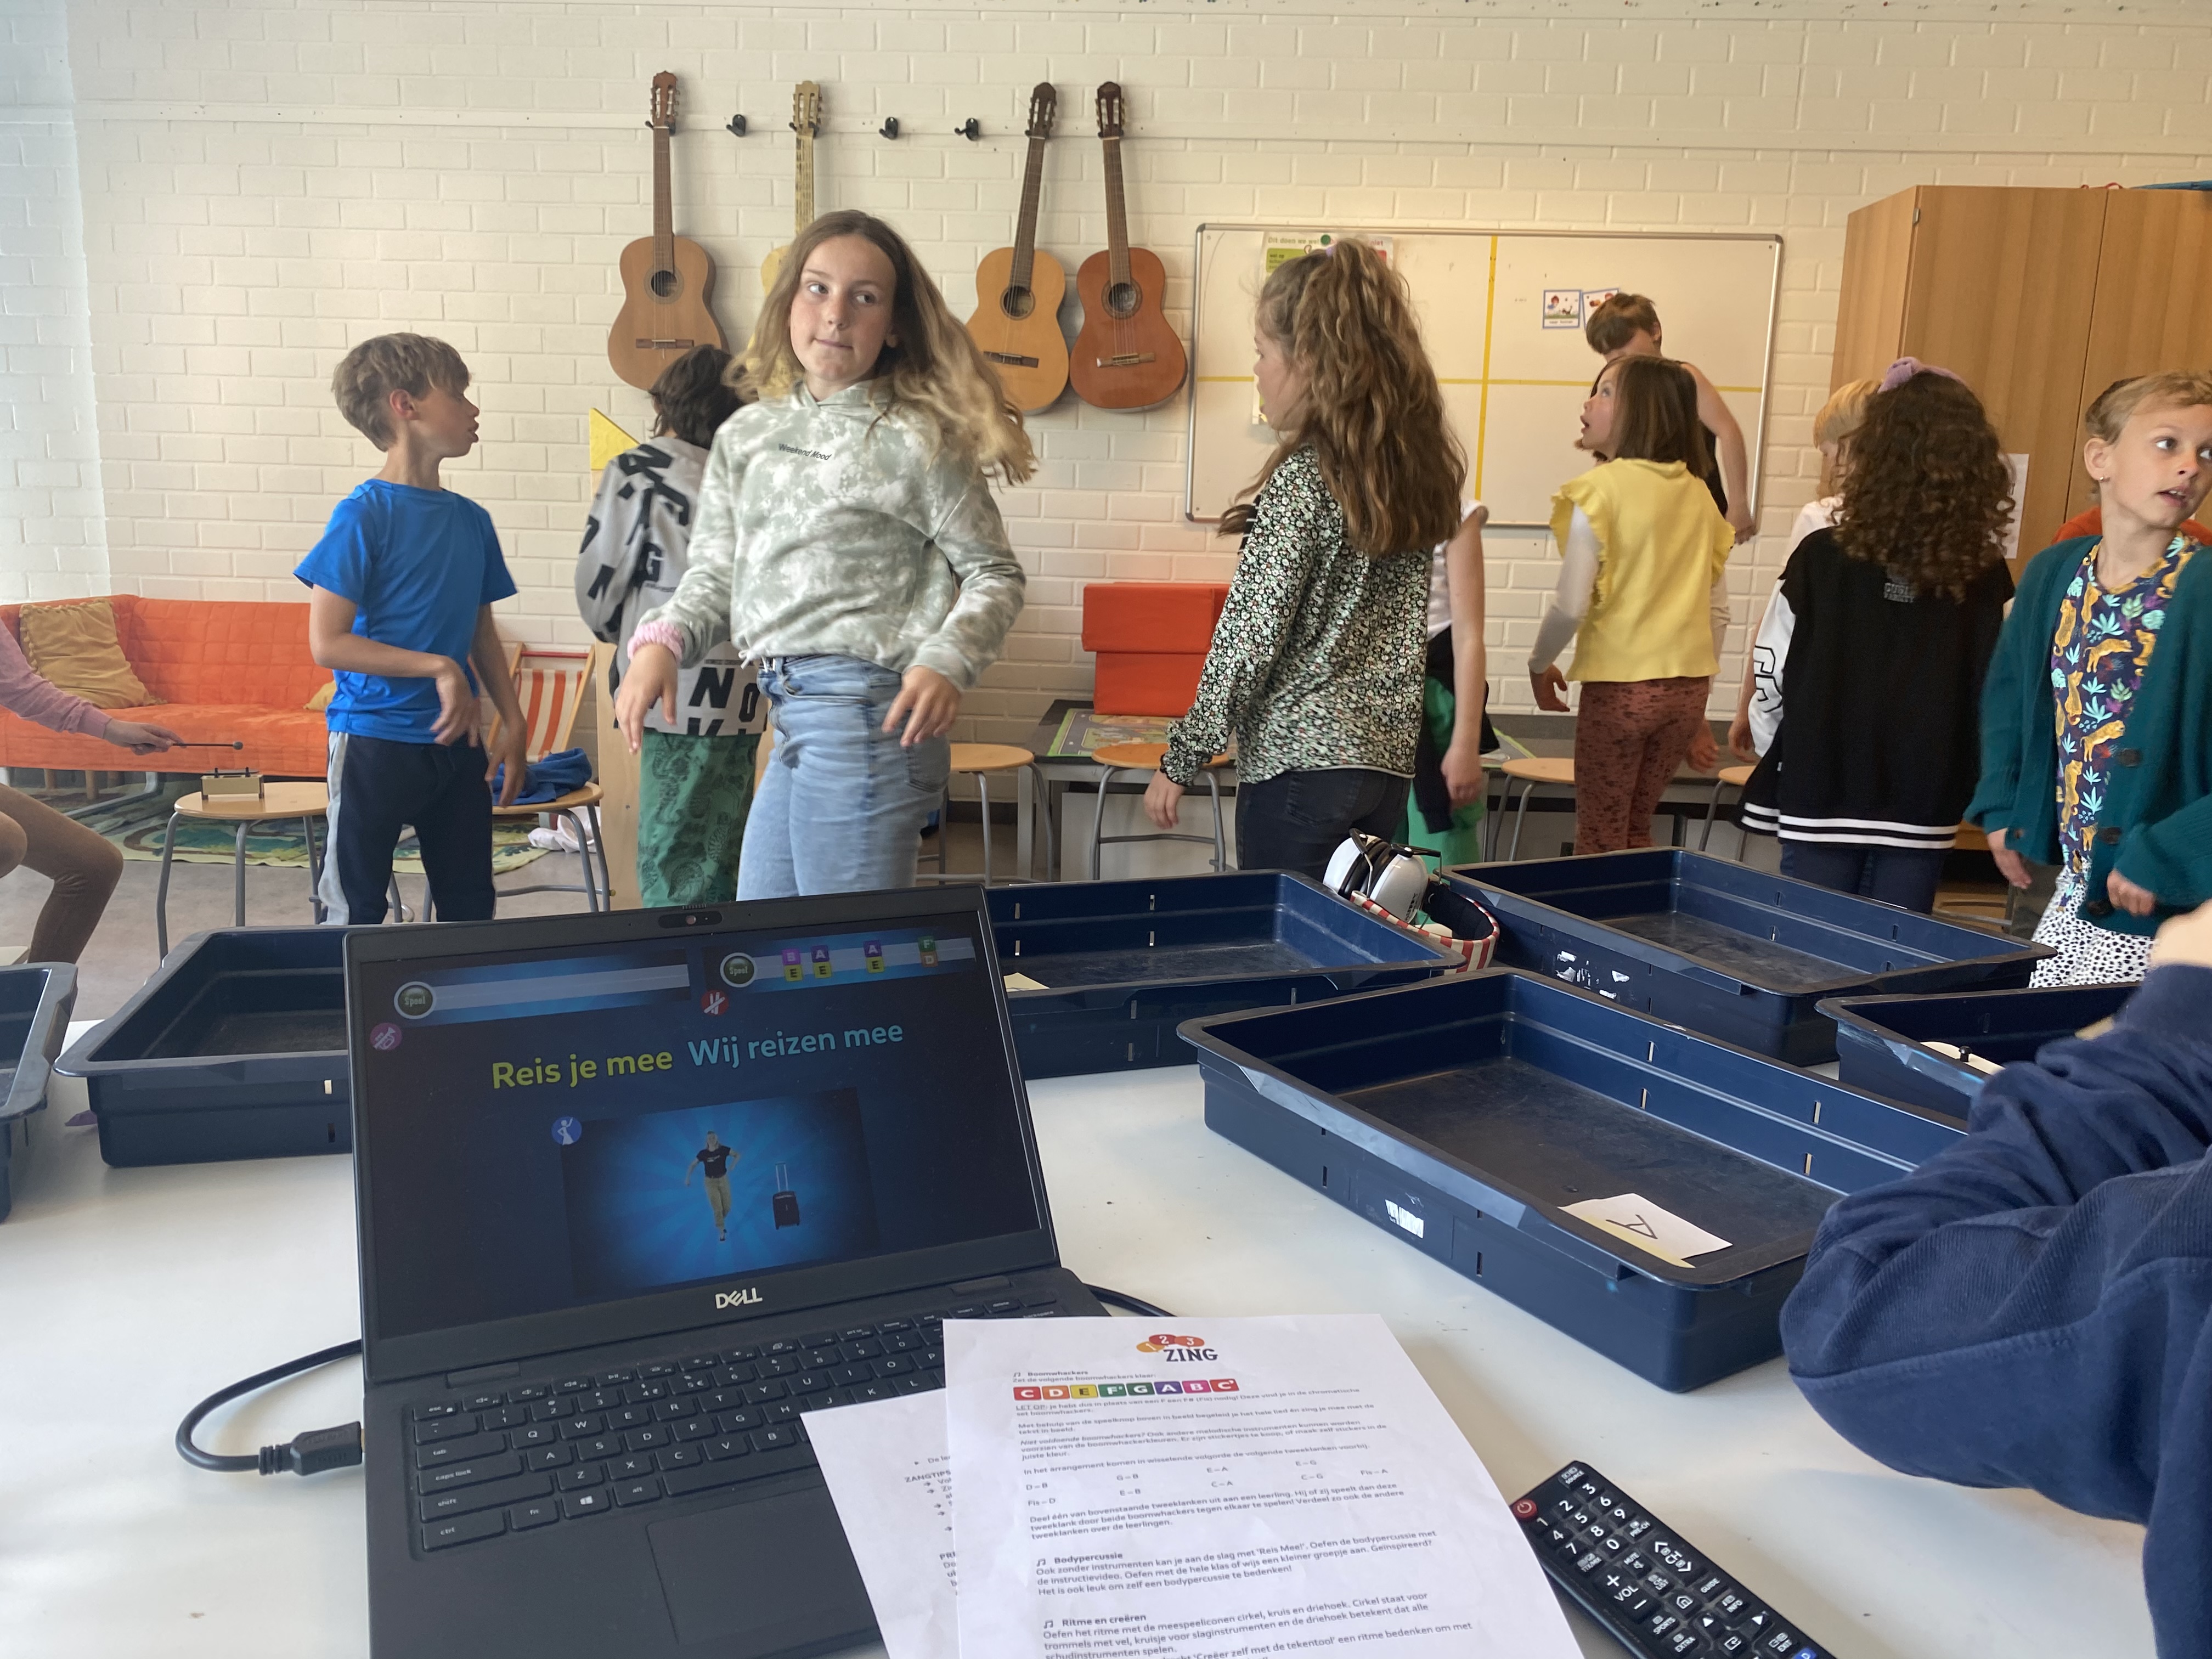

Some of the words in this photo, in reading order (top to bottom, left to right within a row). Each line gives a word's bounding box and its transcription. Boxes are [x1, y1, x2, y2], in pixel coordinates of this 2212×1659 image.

[778, 443, 812, 456] Weekend
[810, 451, 832, 461] Mood
[689, 667, 735, 708] N
[816, 950, 826, 960] A
[868, 945, 878, 954] A
[787, 952, 795, 962] B
[926, 955, 934, 964] D
[819, 966, 827, 975] E
[872, 961, 880, 969] E
[789, 968, 798, 978] E
[492, 1057, 561, 1090] Reis
[569, 1054, 597, 1088] je
[606, 1051, 673, 1076] mee
[687, 1036, 740, 1069] Wij
[747, 1030, 836, 1060] reizen
[844, 1025, 903, 1048] mee
[1605, 1214, 1658, 1239] A
[715, 1286, 763, 1310] DELL
[1159, 1335, 1169, 1345] 2
[1186, 1337, 1194, 1346] 3
[1163, 1348, 1218, 1362] ZING
[1020, 1389, 1034, 1398] C
[1049, 1389, 1064, 1398] D
[1079, 1387, 1089, 1396] E
[1133, 1385, 1148, 1394] G
[1161, 1383, 1176, 1392] A
[1189, 1383, 1204, 1391] B
[1582, 1483, 1596, 1495] 3
[1559, 1499, 1573, 1512] 2
[1600, 1496, 1612, 1507] 6
[1575, 1513, 1588, 1524] 5
[1614, 1508, 1626, 1520] 9
[1537, 1517, 1549, 1527] 1
[1553, 1530, 1565, 1541] 4
[1591, 1526, 1604, 1537] 8
[1036, 1567, 1056, 1576] Ook
[1058, 1565, 1090, 1574] zonder
[1091, 1561, 1154, 1571] instrumenten
[1174, 1558, 1183, 1567] je
[1216, 1552, 1235, 1560] slag
[1310, 1540, 1338, 1549] Oefen
[1352, 1533, 1417, 1544] bodypercussie
[1565, 1542, 1578, 1554] 7
[1054, 1553, 1123, 1564] Bodypercussie
[1624, 1552, 1640, 1566] MUTE
[1051, 1573, 1122, 1584] instructievideo.
[1124, 1571, 1154, 1579] Oefen
[1155, 1568, 1174, 1577] met
[1189, 1565, 1210, 1573] hele
[1231, 1560, 1241, 1568] of
[1280, 1554, 1311, 1562] kleiner
[1313, 1549, 1348, 1560] groepje
[1066, 1585, 1085, 1594] ook
[1086, 1584, 1107, 1593] leuk
[1126, 1581, 1143, 1589] zelf
[1164, 1574, 1230, 1587] bodypercussie
[1243, 1565, 1292, 1578] bedenken!
[1700, 1577, 1720, 1594] GUIDE
[1614, 1584, 1639, 1602] VOL
[1726, 1598, 1743, 1613] INFO
[1043, 1630, 1073, 1639] Oefen
[1075, 1629, 1092, 1637] het
[1121, 1626, 1142, 1634] met
[1143, 1624, 1155, 1632] de
[1157, 1617, 1235, 1630] meespeeliconen
[1237, 1611, 1266, 1622] cirkel,
[1267, 1609, 1291, 1617] kruis
[1306, 1601, 1351, 1612] driehoek.
[1352, 1597, 1380, 1607] Cirkel
[1381, 1595, 1406, 1604] staat
[1109, 1615, 1147, 1624] creëren
[1044, 1640, 1092, 1650] trommels
[1093, 1639, 1114, 1647] met
[1115, 1637, 1132, 1646] vel,
[1134, 1635, 1166, 1645] kruisje
[1168, 1633, 1190, 1641] voor
[1192, 1622, 1276, 1639] slaginstrumenten
[1291, 1617, 1304, 1626] de
[1306, 1612, 1348, 1624] driehoek
[1348, 1608, 1392, 1619] betekent
[1393, 1606, 1410, 1614] dat
[1412, 1604, 1429, 1612] alle
[1652, 1616, 1677, 1635] SPORTS
[1674, 1635, 1696, 1653] EXTRA
